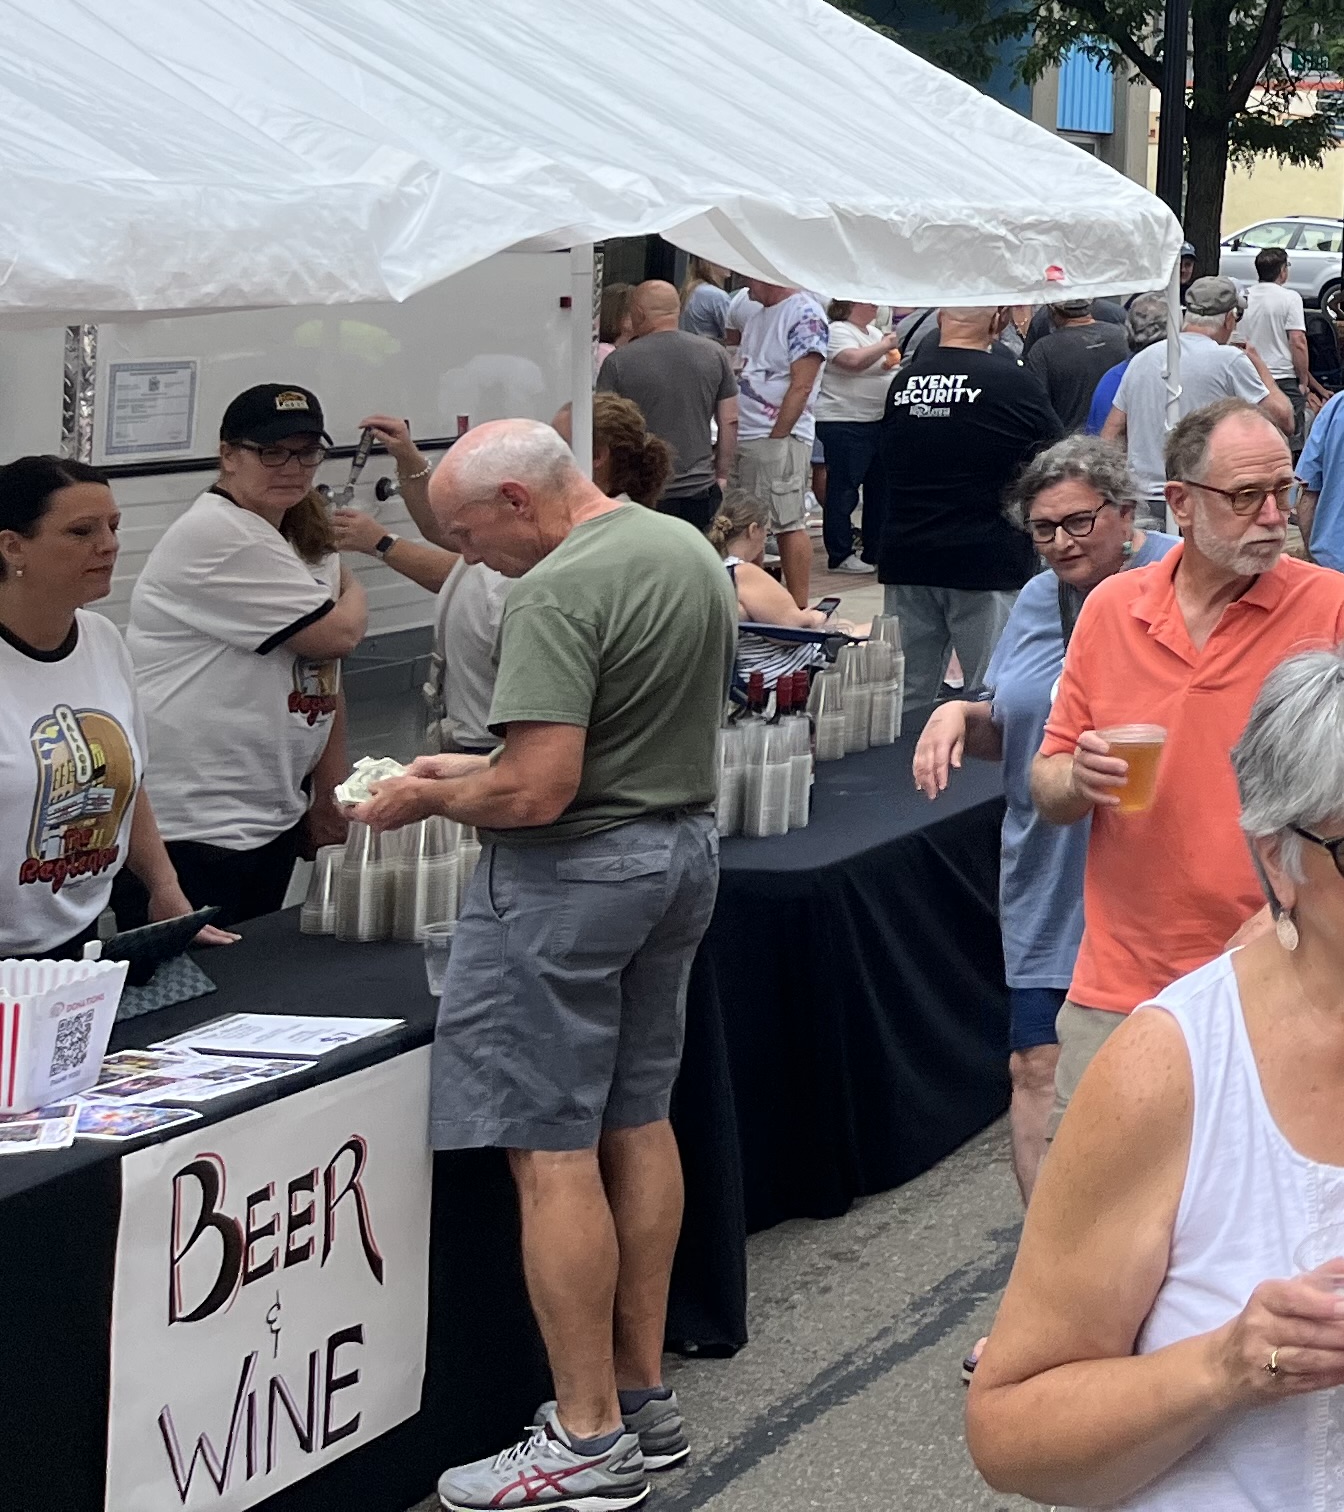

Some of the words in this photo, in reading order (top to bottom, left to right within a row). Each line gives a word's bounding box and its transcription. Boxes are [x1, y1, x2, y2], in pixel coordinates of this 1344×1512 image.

[893, 388, 982, 406] SECURITY
[906, 374, 968, 390] EVENT
[60, 711, 88, 777] PALACE
[168, 1133, 384, 1327] BEER
[158, 1323, 365, 1505] WINE
